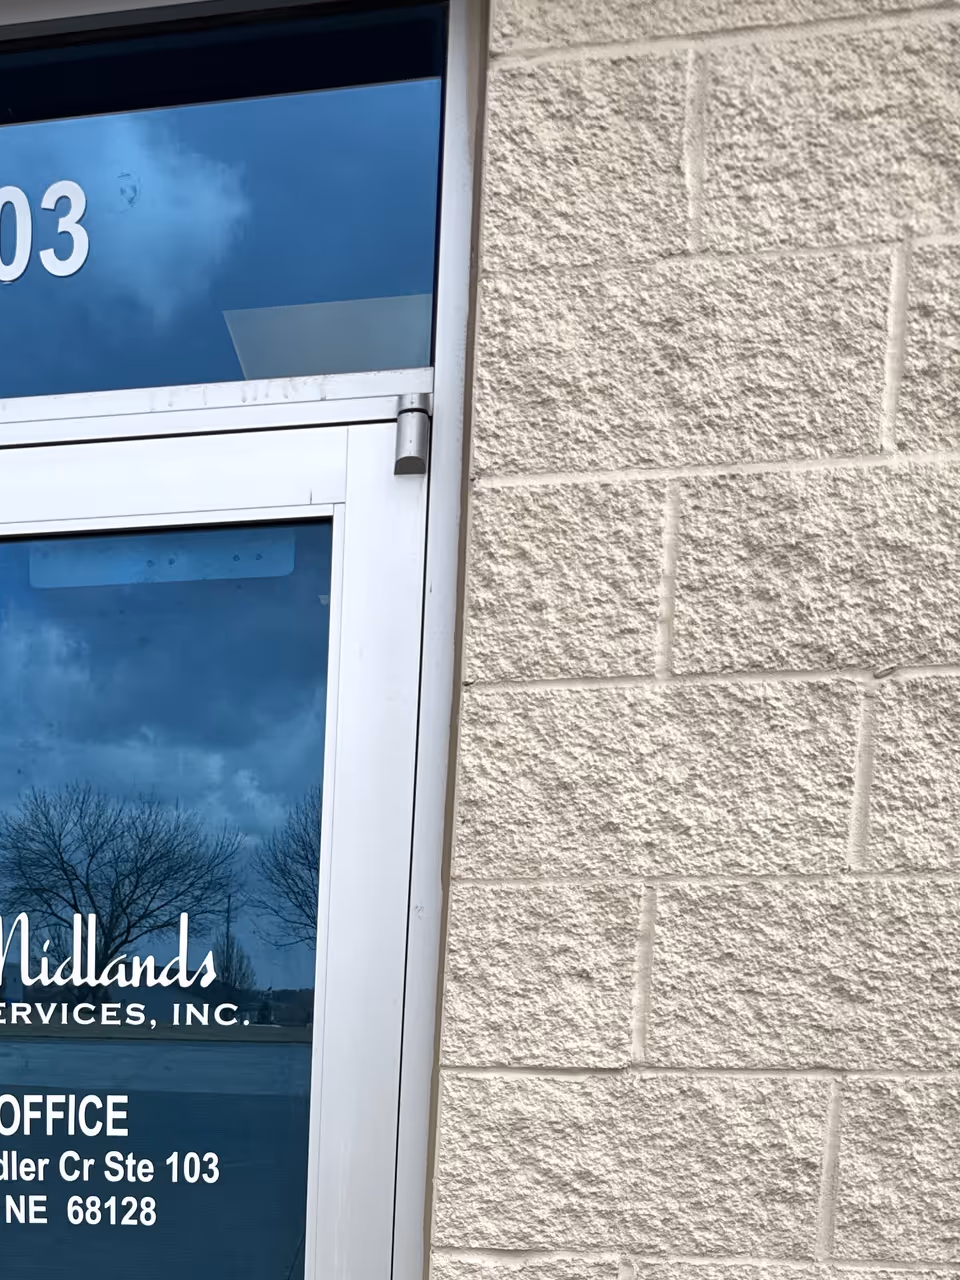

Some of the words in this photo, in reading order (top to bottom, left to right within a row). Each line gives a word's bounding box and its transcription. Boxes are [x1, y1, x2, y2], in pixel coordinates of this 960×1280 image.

[172, 1003, 250, 1026] INC.
[59, 1150, 96, 1182] Cr
[103, 1150, 155, 1183] Ste
[165, 1151, 220, 1184] 103
[5, 1194, 48, 1224] NE
[66, 1195, 157, 1227] 68128
